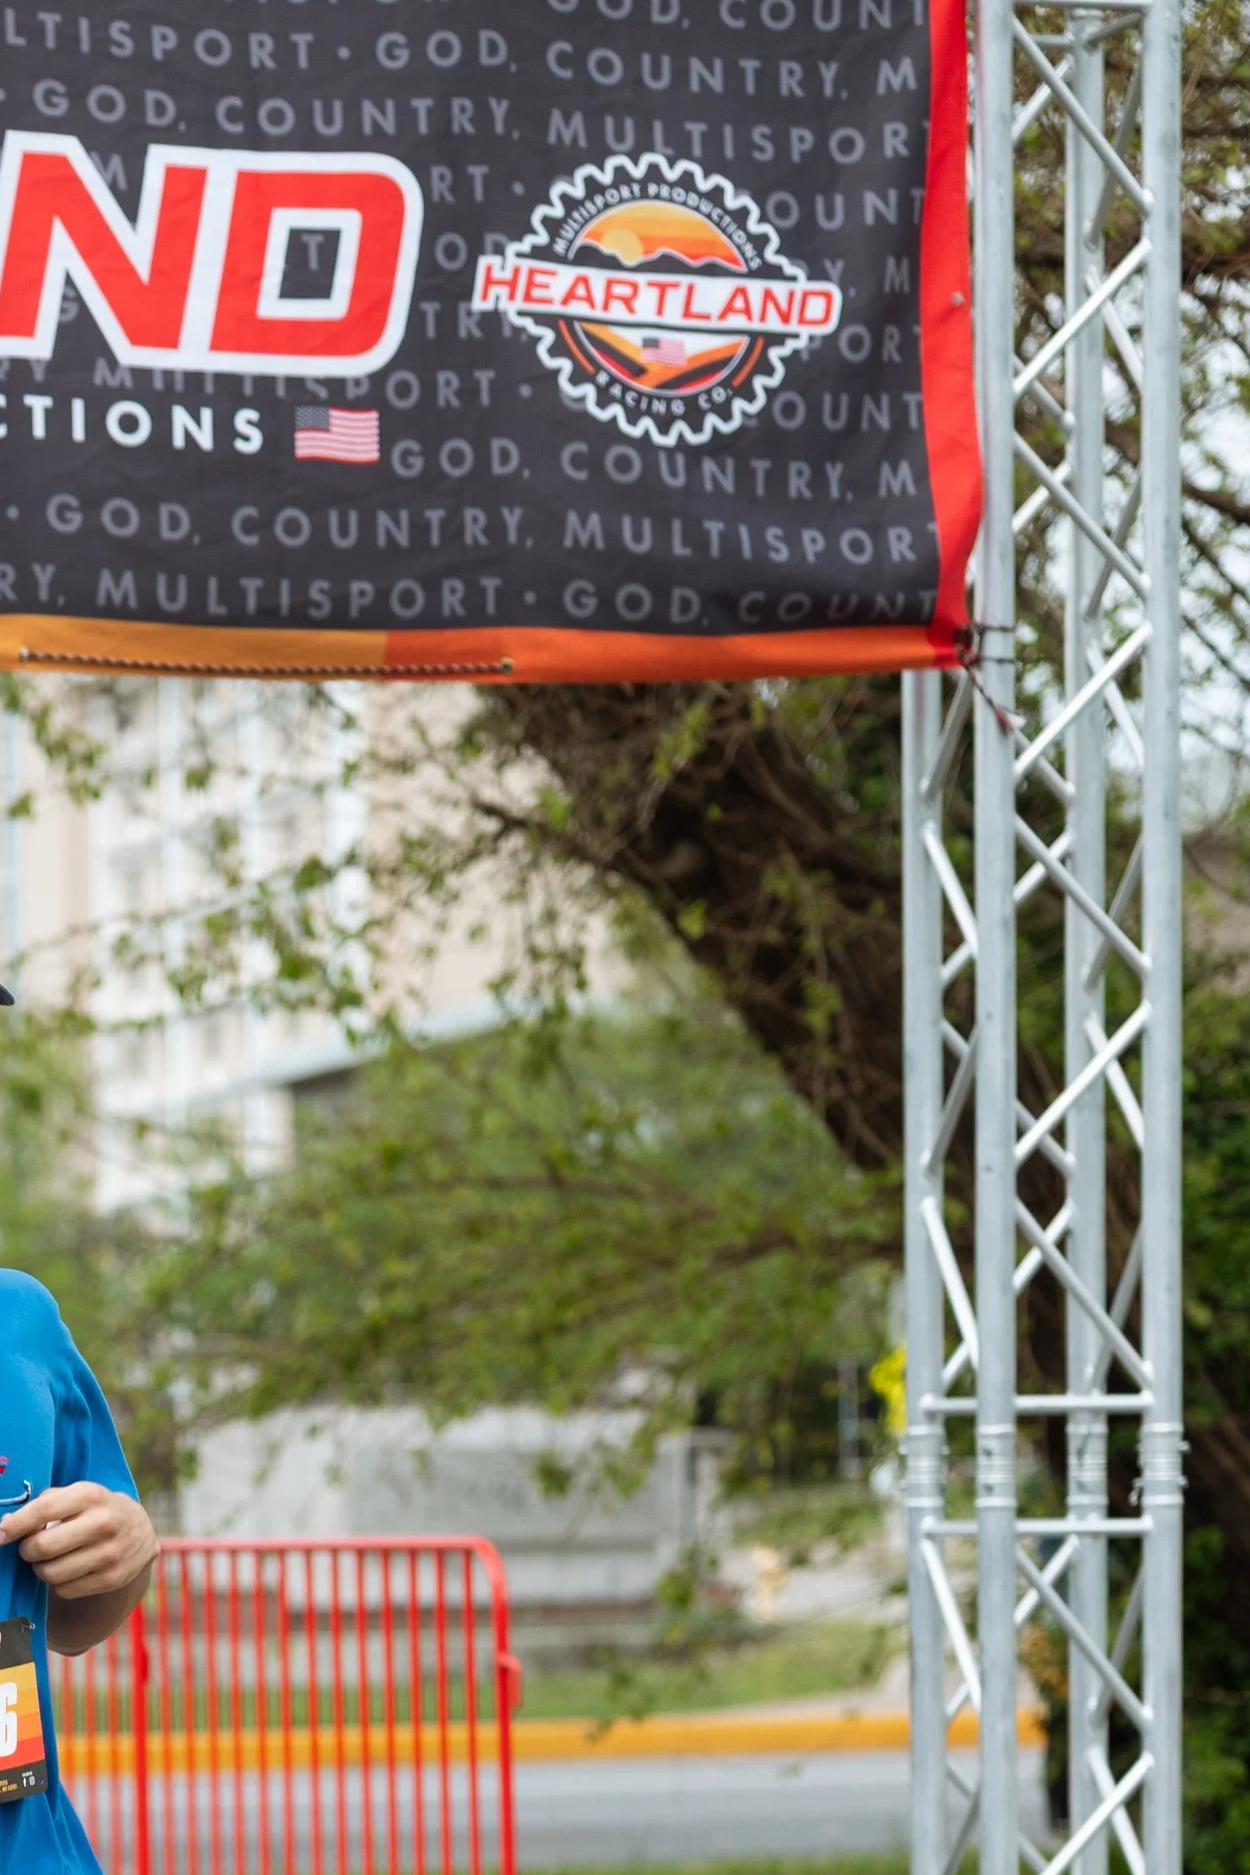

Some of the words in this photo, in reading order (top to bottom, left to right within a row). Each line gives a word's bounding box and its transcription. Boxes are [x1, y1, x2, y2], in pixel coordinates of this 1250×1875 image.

[376, 30, 516, 71] GOD,
[546, 41, 847, 99] COUNTRY,
[33, 79, 185, 131] GOD,
[216, 96, 518, 138] COUNTRY,
[547, 108, 928, 164] MULTISPOR
[552, 181, 642, 256] MULTISPORT
[648, 182, 762, 271] PRODUCTIONS
[477, 262, 835, 327] HEARTLAND
[595, 370, 686, 416] RACING
[391, 438, 530, 479] GOD,
[560, 438, 852, 501] COUNTRY,
[46, 496, 199, 544] GOD,
[231, 506, 533, 548] COUNTRY,
[97, 568, 501, 617] MULTISPORT
[563, 579, 709, 627] GOD,
